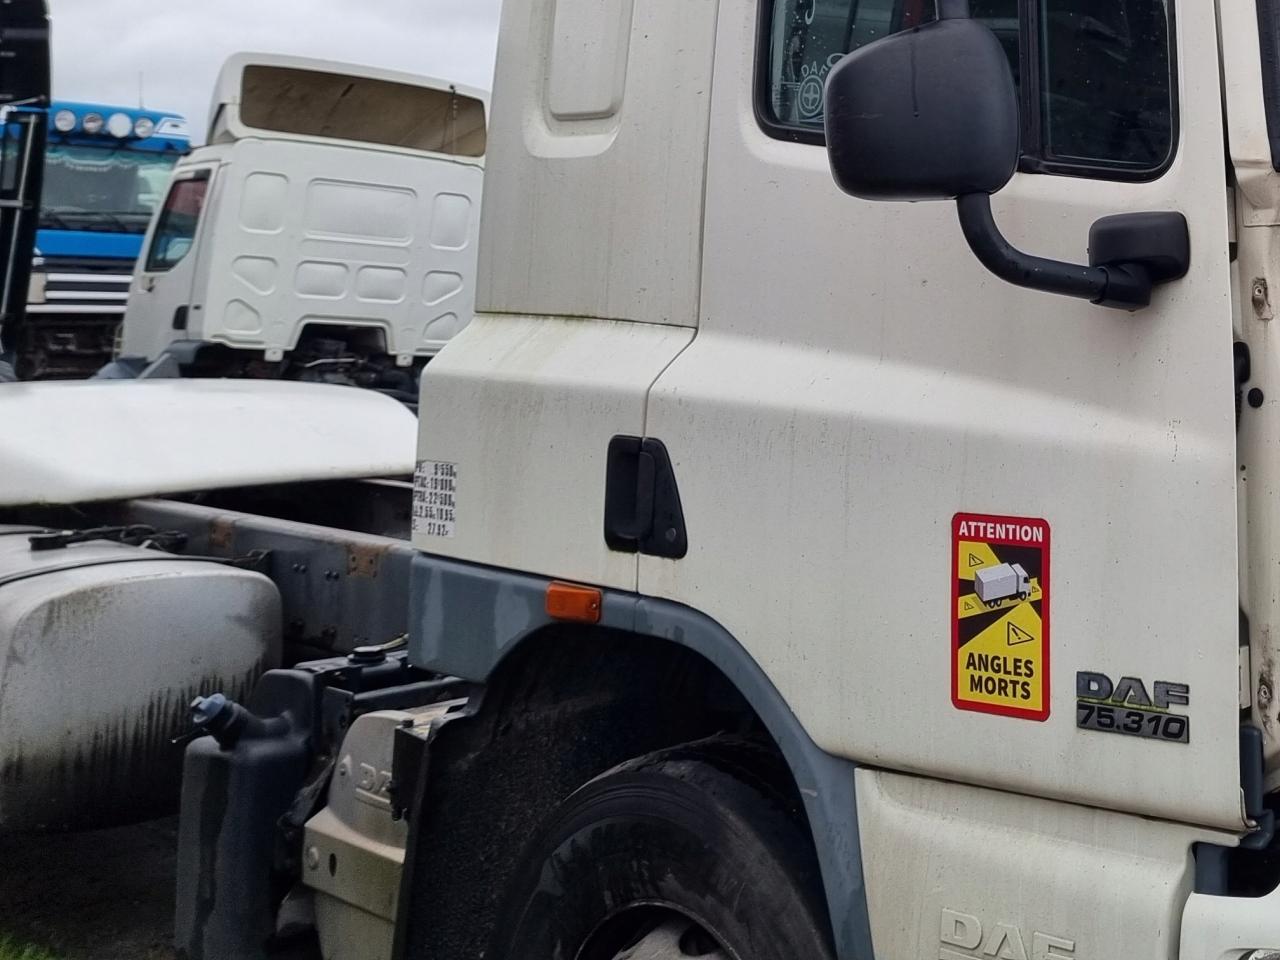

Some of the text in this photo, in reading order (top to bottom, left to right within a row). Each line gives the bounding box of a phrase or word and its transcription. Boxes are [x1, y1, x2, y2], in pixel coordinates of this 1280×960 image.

[801, 61, 829, 77] DAF
[958, 521, 1043, 542] ATTENTION
[965, 652, 1034, 678] ANGLES
[969, 674, 1031, 700] MORTS
[1077, 671, 1189, 709] DAF
[1077, 703, 1186, 739] 75.310
[940, 907, 1076, 960] DAF
